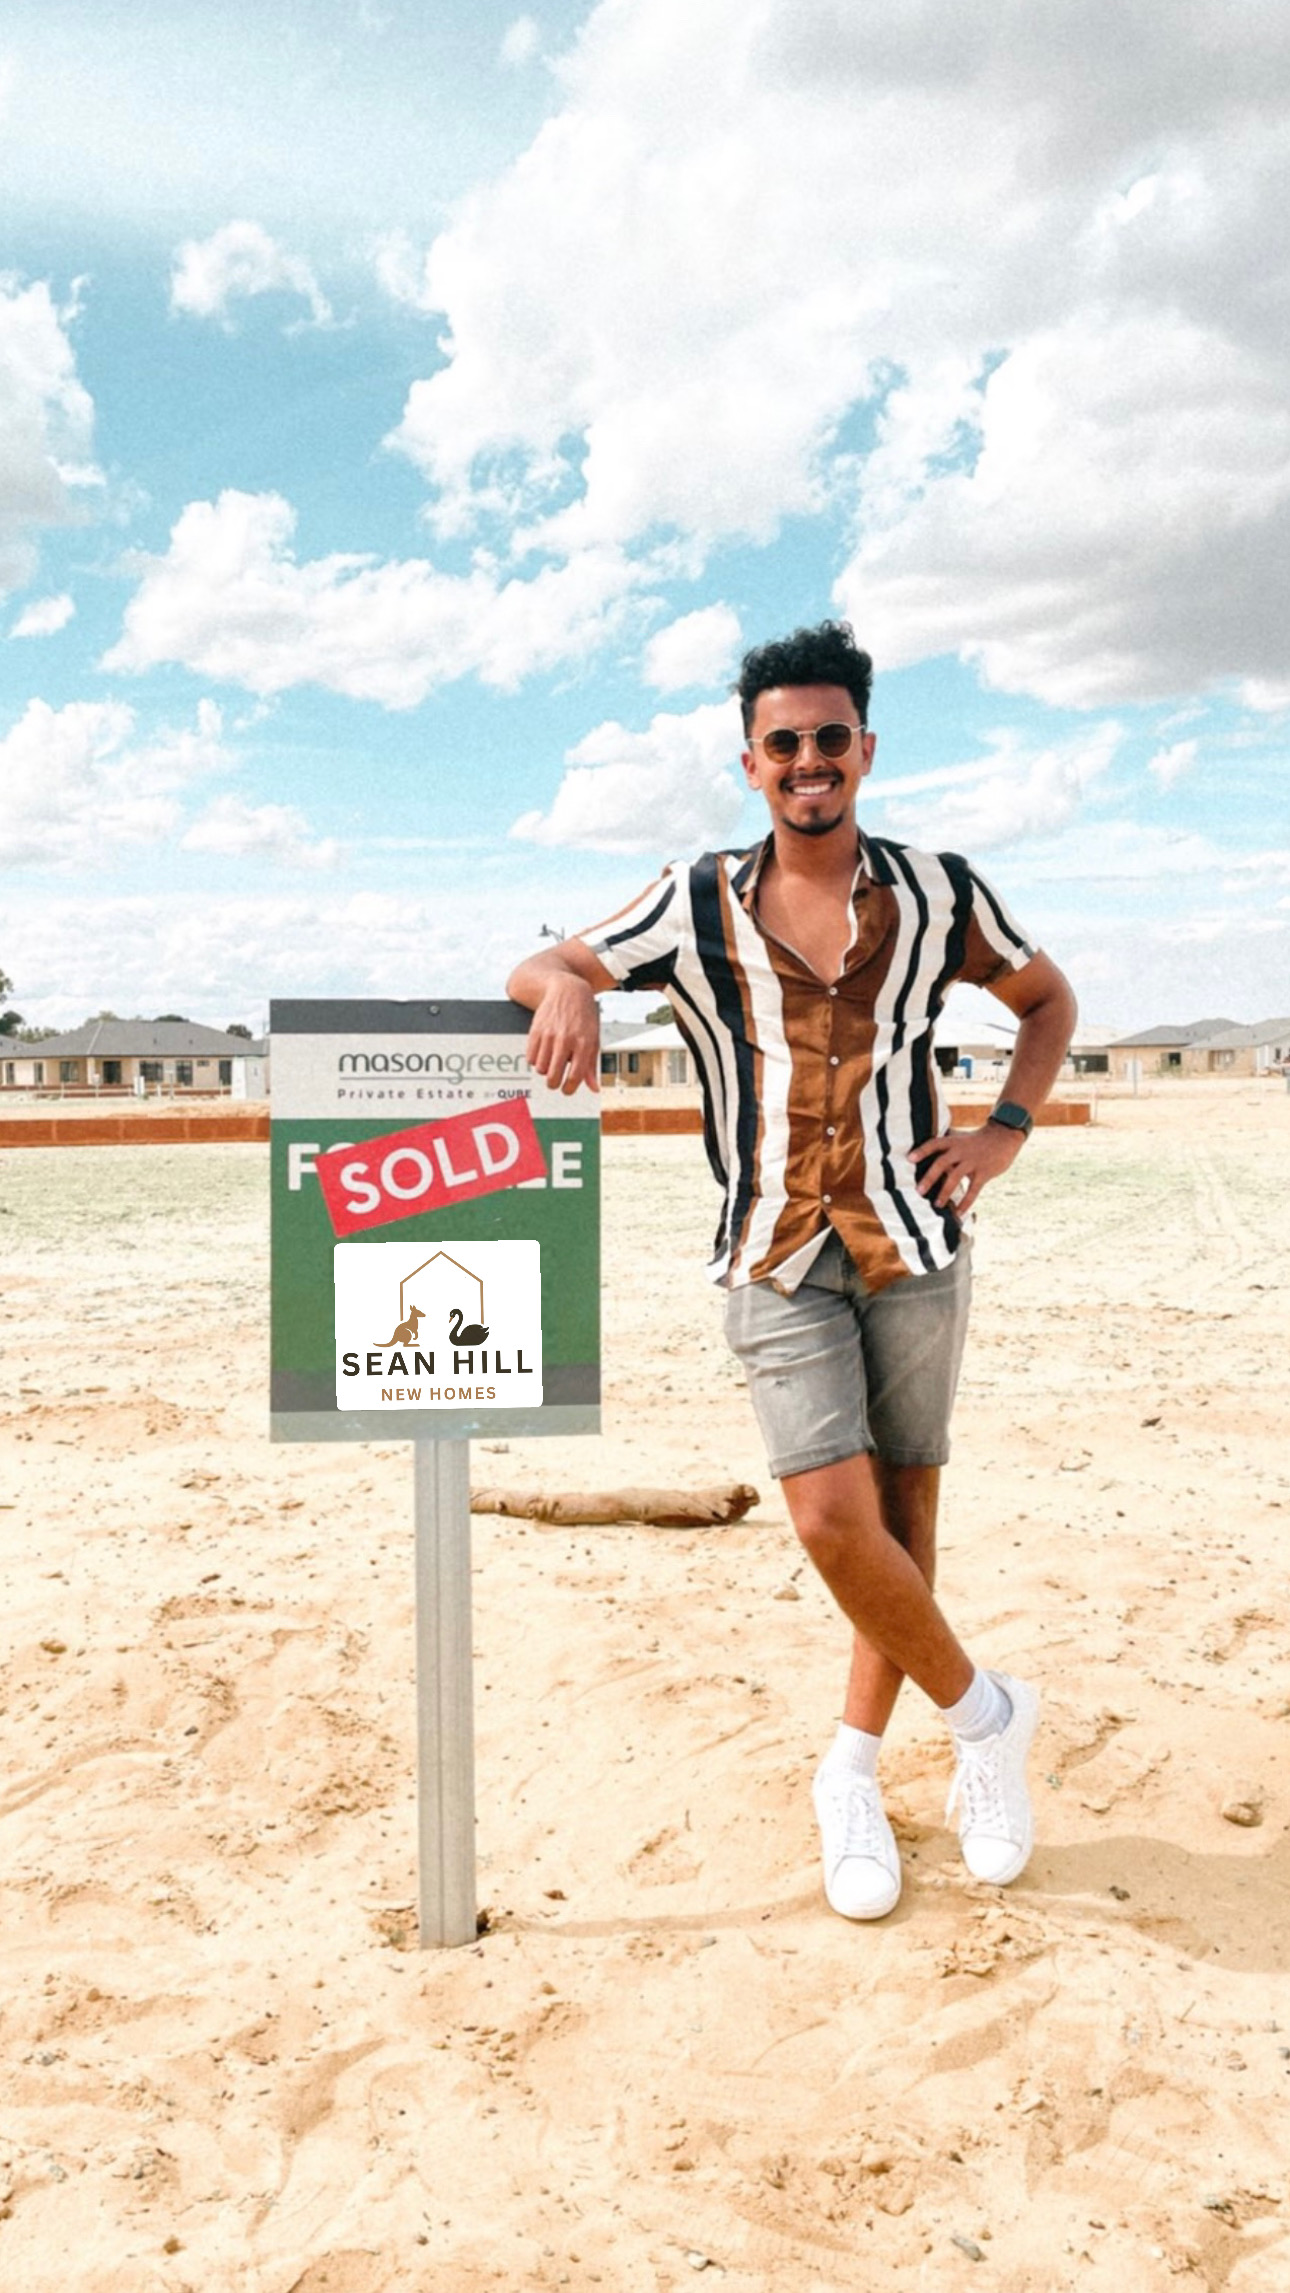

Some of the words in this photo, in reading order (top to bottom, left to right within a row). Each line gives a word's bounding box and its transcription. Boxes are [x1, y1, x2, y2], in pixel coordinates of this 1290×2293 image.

[337, 1088, 405, 1099] Private
[416, 1088, 475, 1099] Estate
[340, 1123, 520, 1214] SOLD
